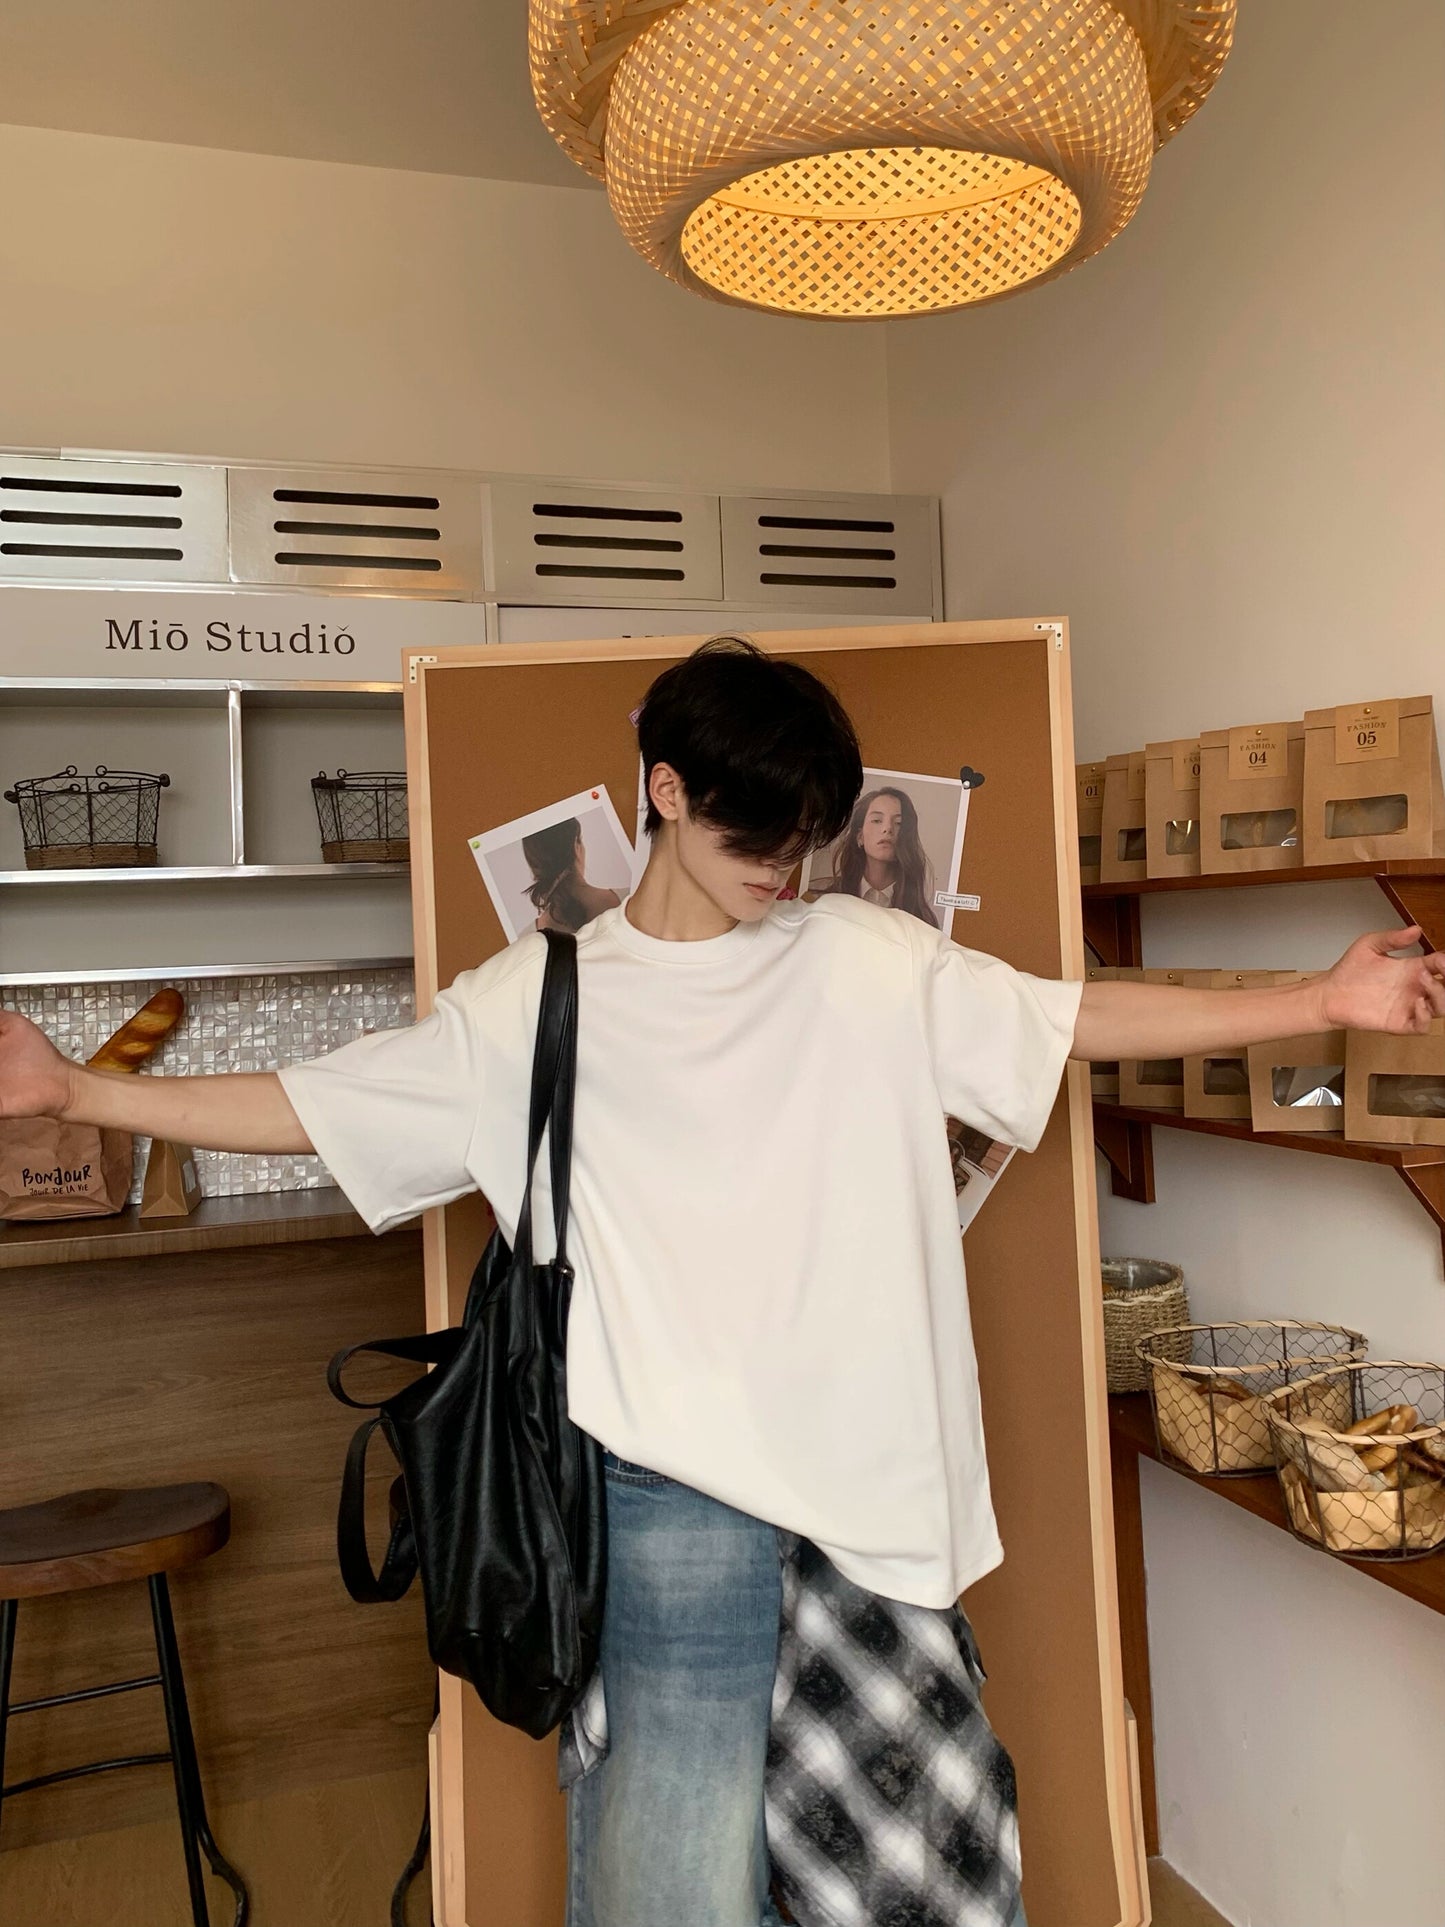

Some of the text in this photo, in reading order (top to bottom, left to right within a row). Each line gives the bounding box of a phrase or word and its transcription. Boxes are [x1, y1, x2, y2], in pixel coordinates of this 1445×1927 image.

[1347, 722, 1387, 732] FASHION
[1357, 731, 1377, 746] 05
[1249, 751, 1267, 765] 04
[1085, 785, 1098, 797] 01
